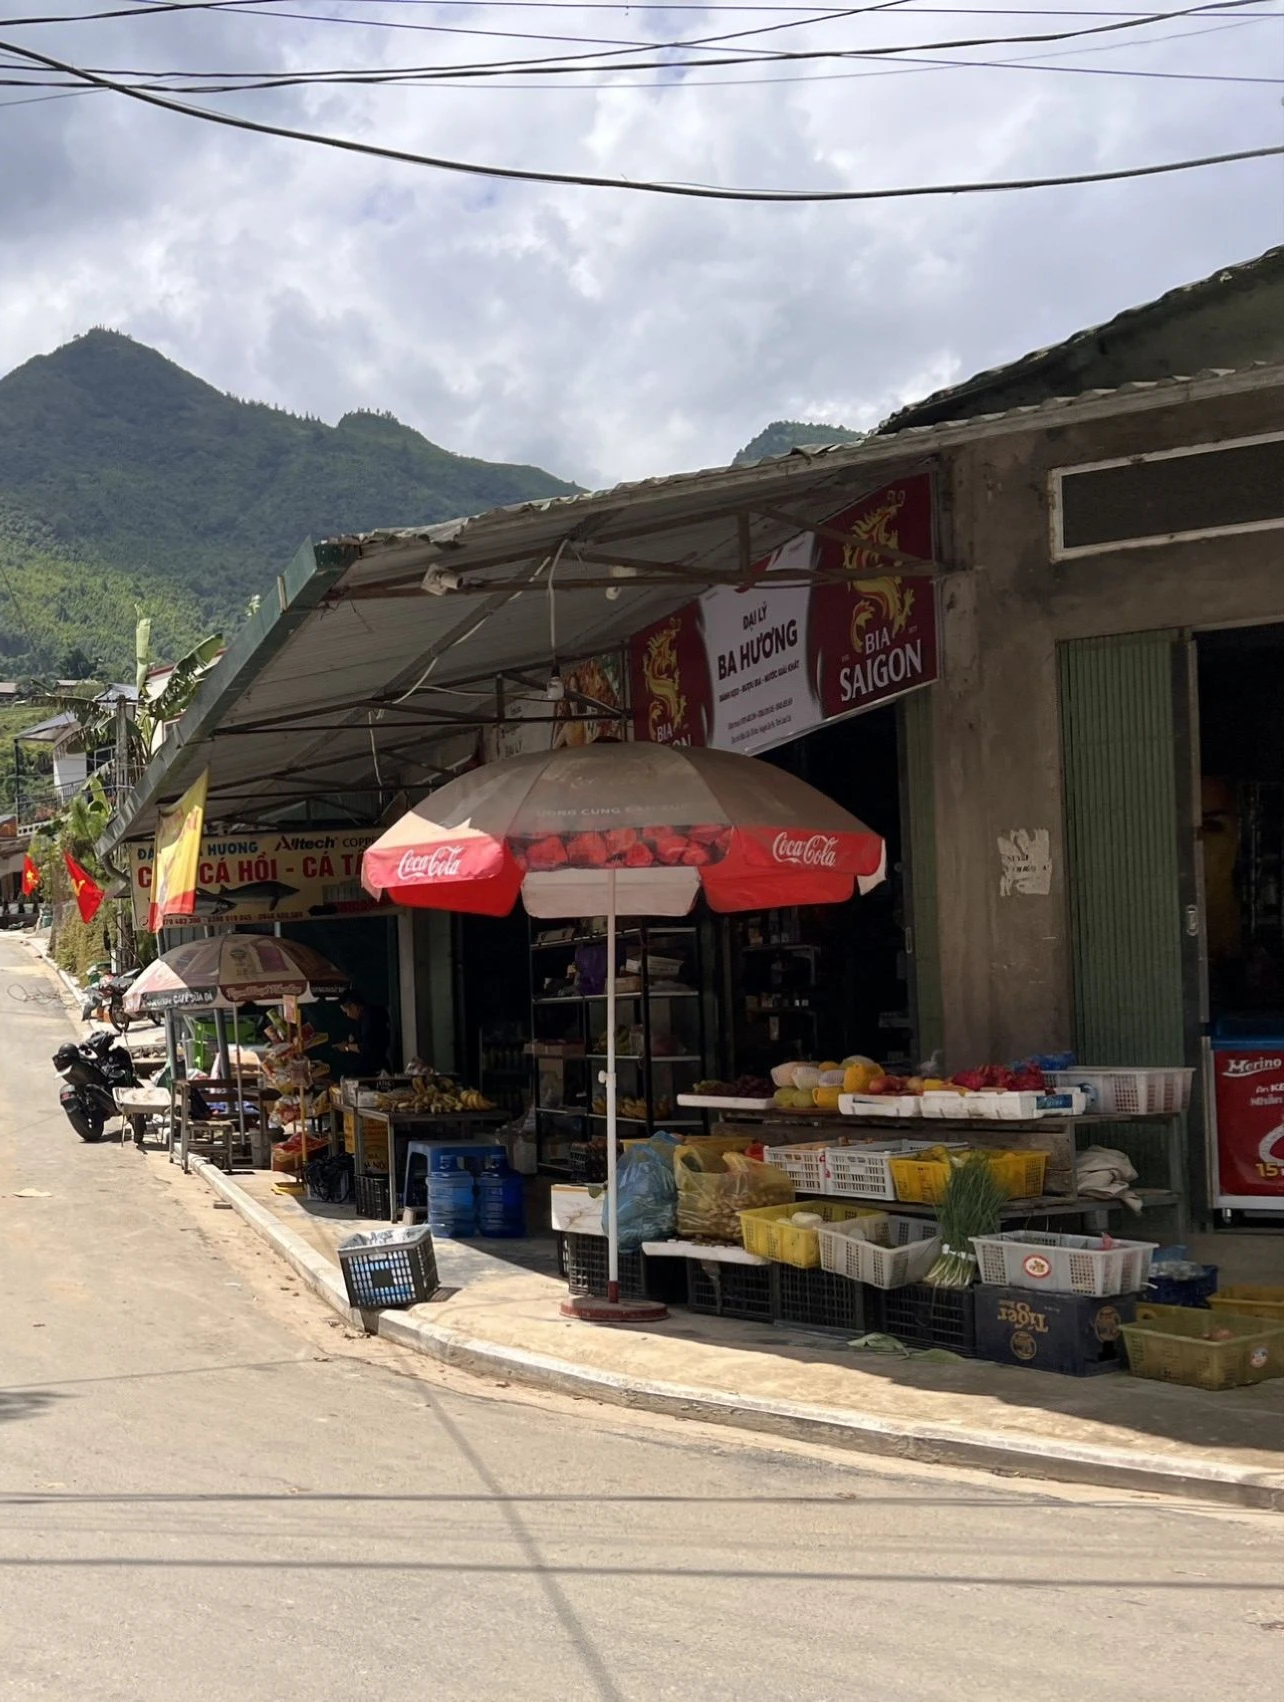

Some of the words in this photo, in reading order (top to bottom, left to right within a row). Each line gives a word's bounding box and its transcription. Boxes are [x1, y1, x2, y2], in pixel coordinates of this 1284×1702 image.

[717, 650, 738, 681] BA
[739, 619, 798, 671] HƯƠNG
[864, 626, 891, 655] BIA
[839, 639, 922, 702] SAIGON
[656, 722, 674, 743] BIA
[199, 857, 231, 884] CÁ
[237, 851, 278, 882] HỒI
[302, 851, 335, 878] CÁ
[1227, 1056, 1282, 1074] Merino
[1255, 1162, 1279, 1177] 15
[996, 1302, 1049, 1333] Tiger
